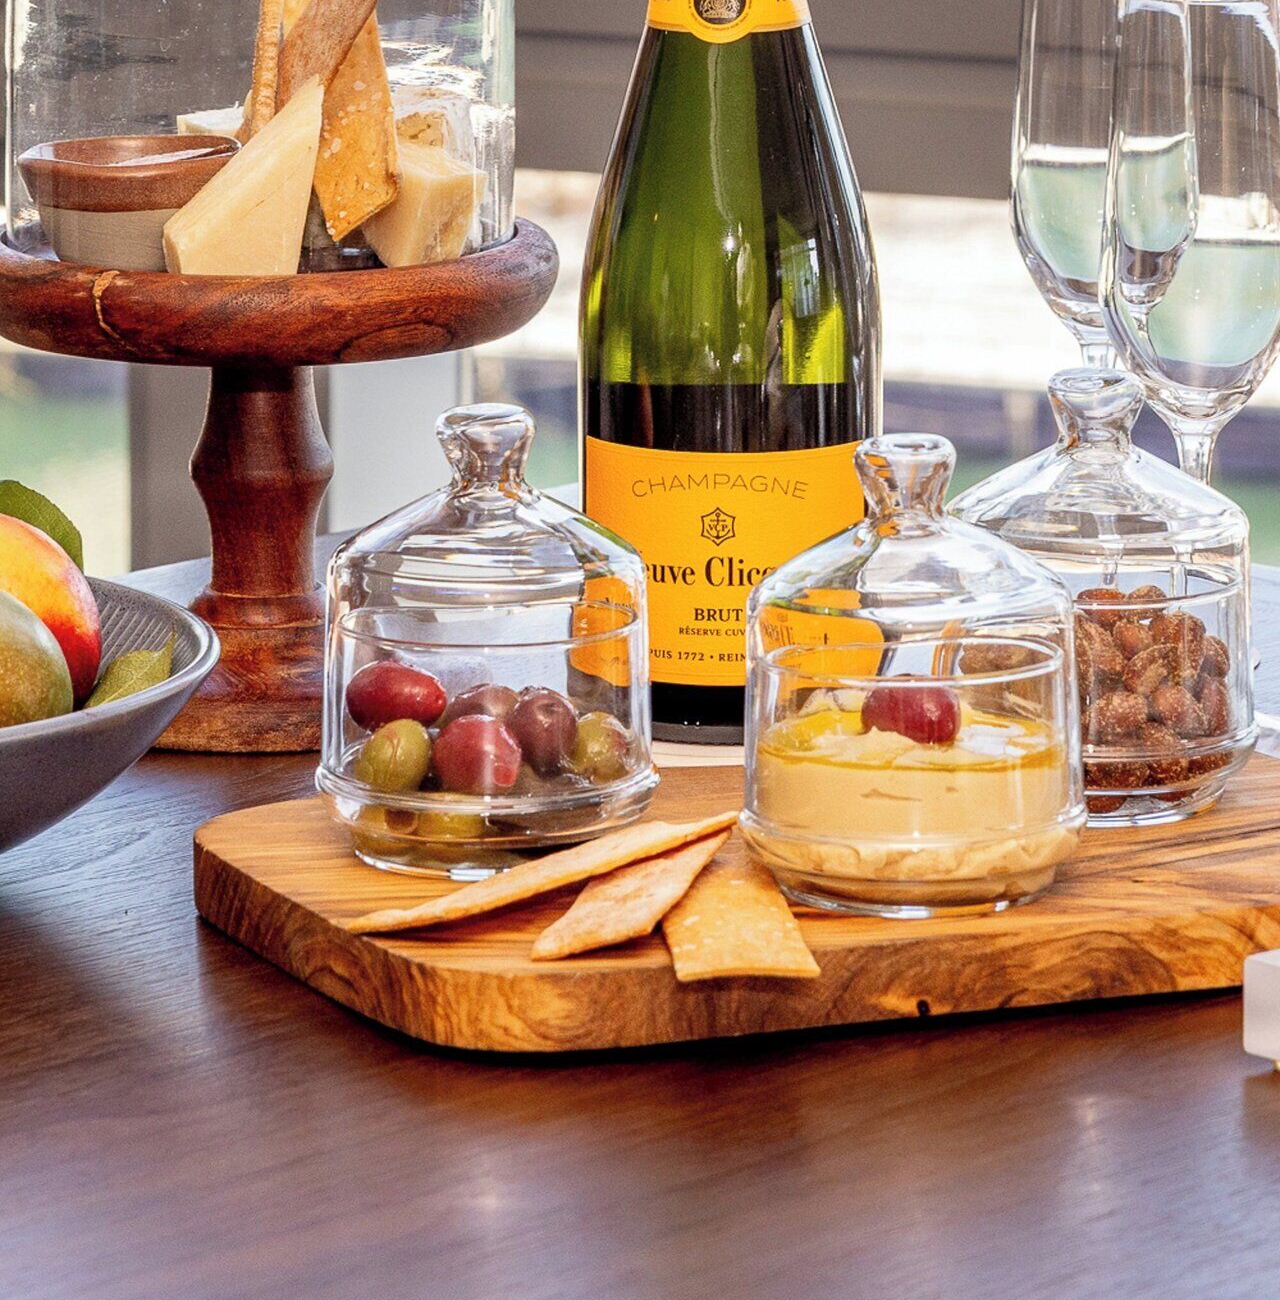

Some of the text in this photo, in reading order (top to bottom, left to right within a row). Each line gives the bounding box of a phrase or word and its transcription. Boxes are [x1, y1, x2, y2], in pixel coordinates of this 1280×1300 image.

[631, 473, 810, 500] CHAMPAGNE
[645, 563, 696, 586] uve
[693, 607, 744, 622] BRUT
[678, 625, 722, 637] RÉSERVE
[677, 651, 705, 661] 1772
